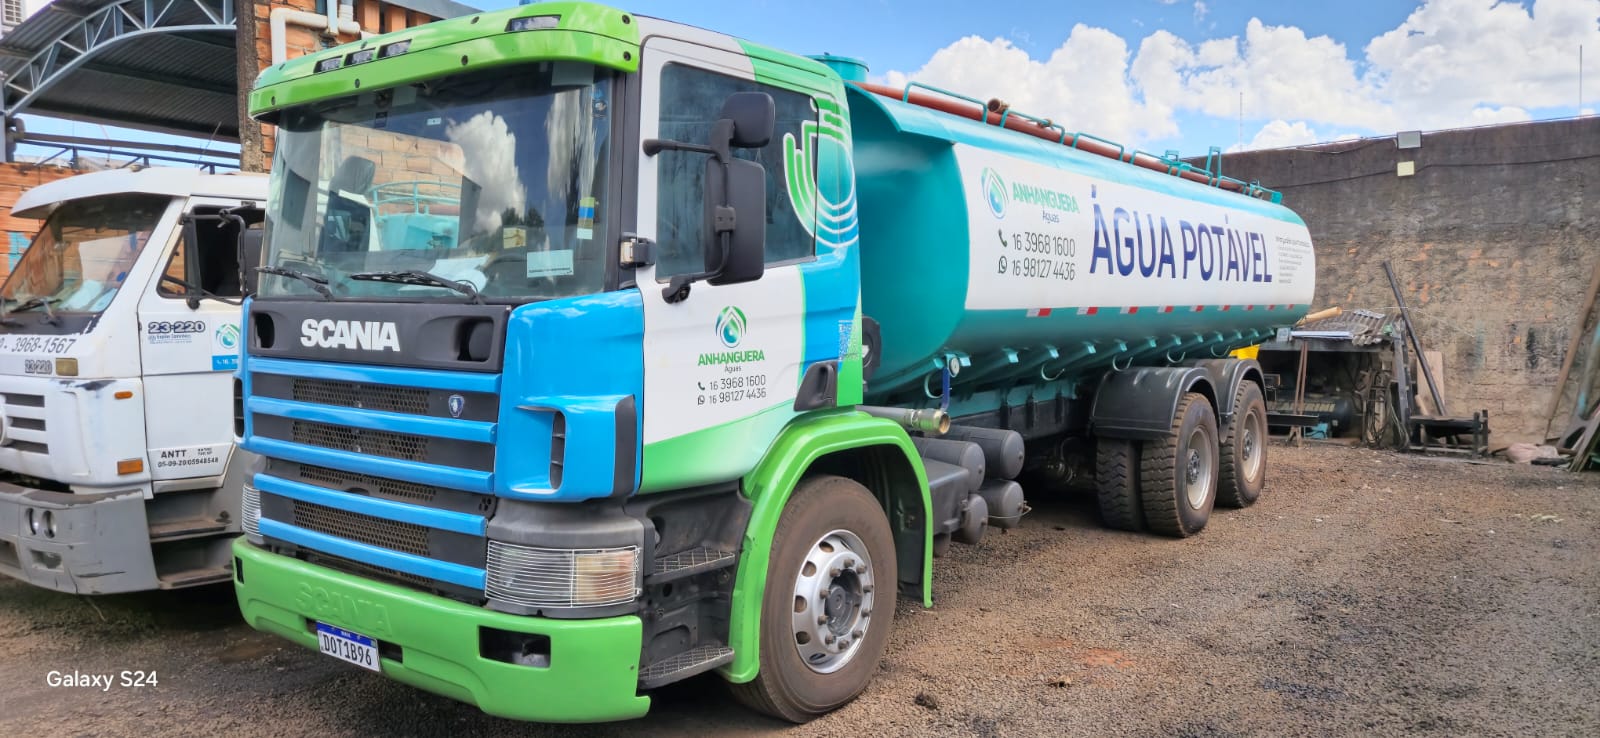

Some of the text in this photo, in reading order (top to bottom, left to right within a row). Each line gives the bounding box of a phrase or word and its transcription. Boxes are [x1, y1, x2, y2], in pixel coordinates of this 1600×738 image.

[1012, 181, 1080, 214] ANHANGUERA
[1089, 184, 1176, 279] ÁGUA
[1179, 213, 1272, 283] POTÁVEL
[1012, 231, 1076, 258] 16 3968 1600
[1012, 256, 1076, 281] 16 98127 4436
[148, 320, 206, 334] 23-220
[300, 318, 401, 352] SCANIA
[11, 337, 77, 354] 3968-1567
[697, 349, 765, 366] ANHANGUERA
[709, 374, 766, 391] 16 3968 1600
[709, 387, 767, 404] 16 98127 4436
[161, 449, 187, 459] ANTT
[322, 633, 372, 666] DOT1B96
